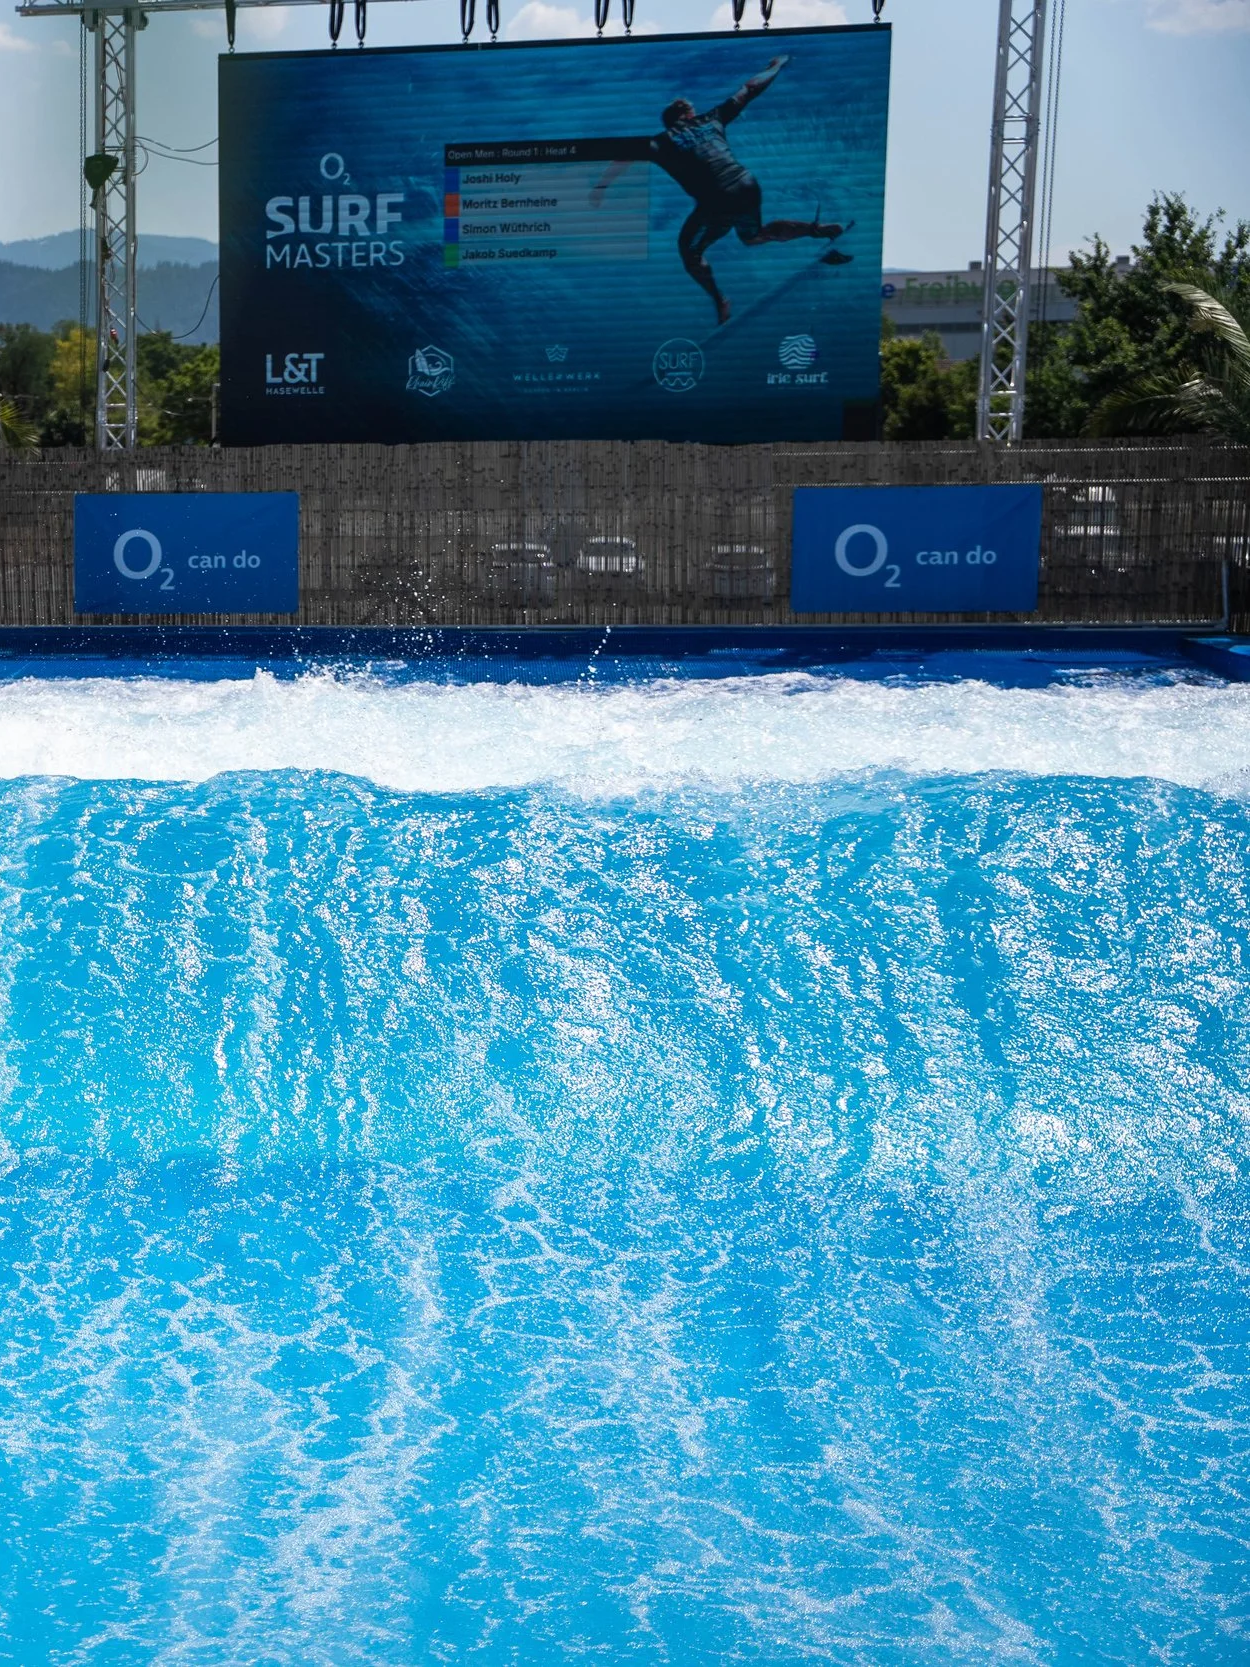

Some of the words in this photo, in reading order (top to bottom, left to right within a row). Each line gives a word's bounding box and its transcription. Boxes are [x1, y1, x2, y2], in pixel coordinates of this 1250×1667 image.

[447, 150, 471, 160] Open
[474, 149, 495, 158] Men
[502, 148, 531, 157] Round
[545, 146, 568, 156] Heat
[462, 174, 494, 184] Joshi
[495, 172, 522, 185] Holy
[462, 199, 498, 210] Moritz
[265, 193, 405, 239] SURF
[462, 223, 497, 234] Simon
[499, 221, 552, 233] Wüthrich
[266, 240, 405, 269] MASTERS
[462, 249, 495, 260] Jakob
[498, 248, 557, 260] Suedkamp
[905, 275, 1017, 298] Freibug
[265, 352, 325, 384] L&T
[658, 351, 699, 370] SURF
[766, 372, 791, 385] irie
[265, 386, 325, 396] HASEWELLE
[187, 554, 226, 569] can
[232, 550, 261, 569] do
[915, 549, 958, 565] can
[965, 545, 997, 565] do
